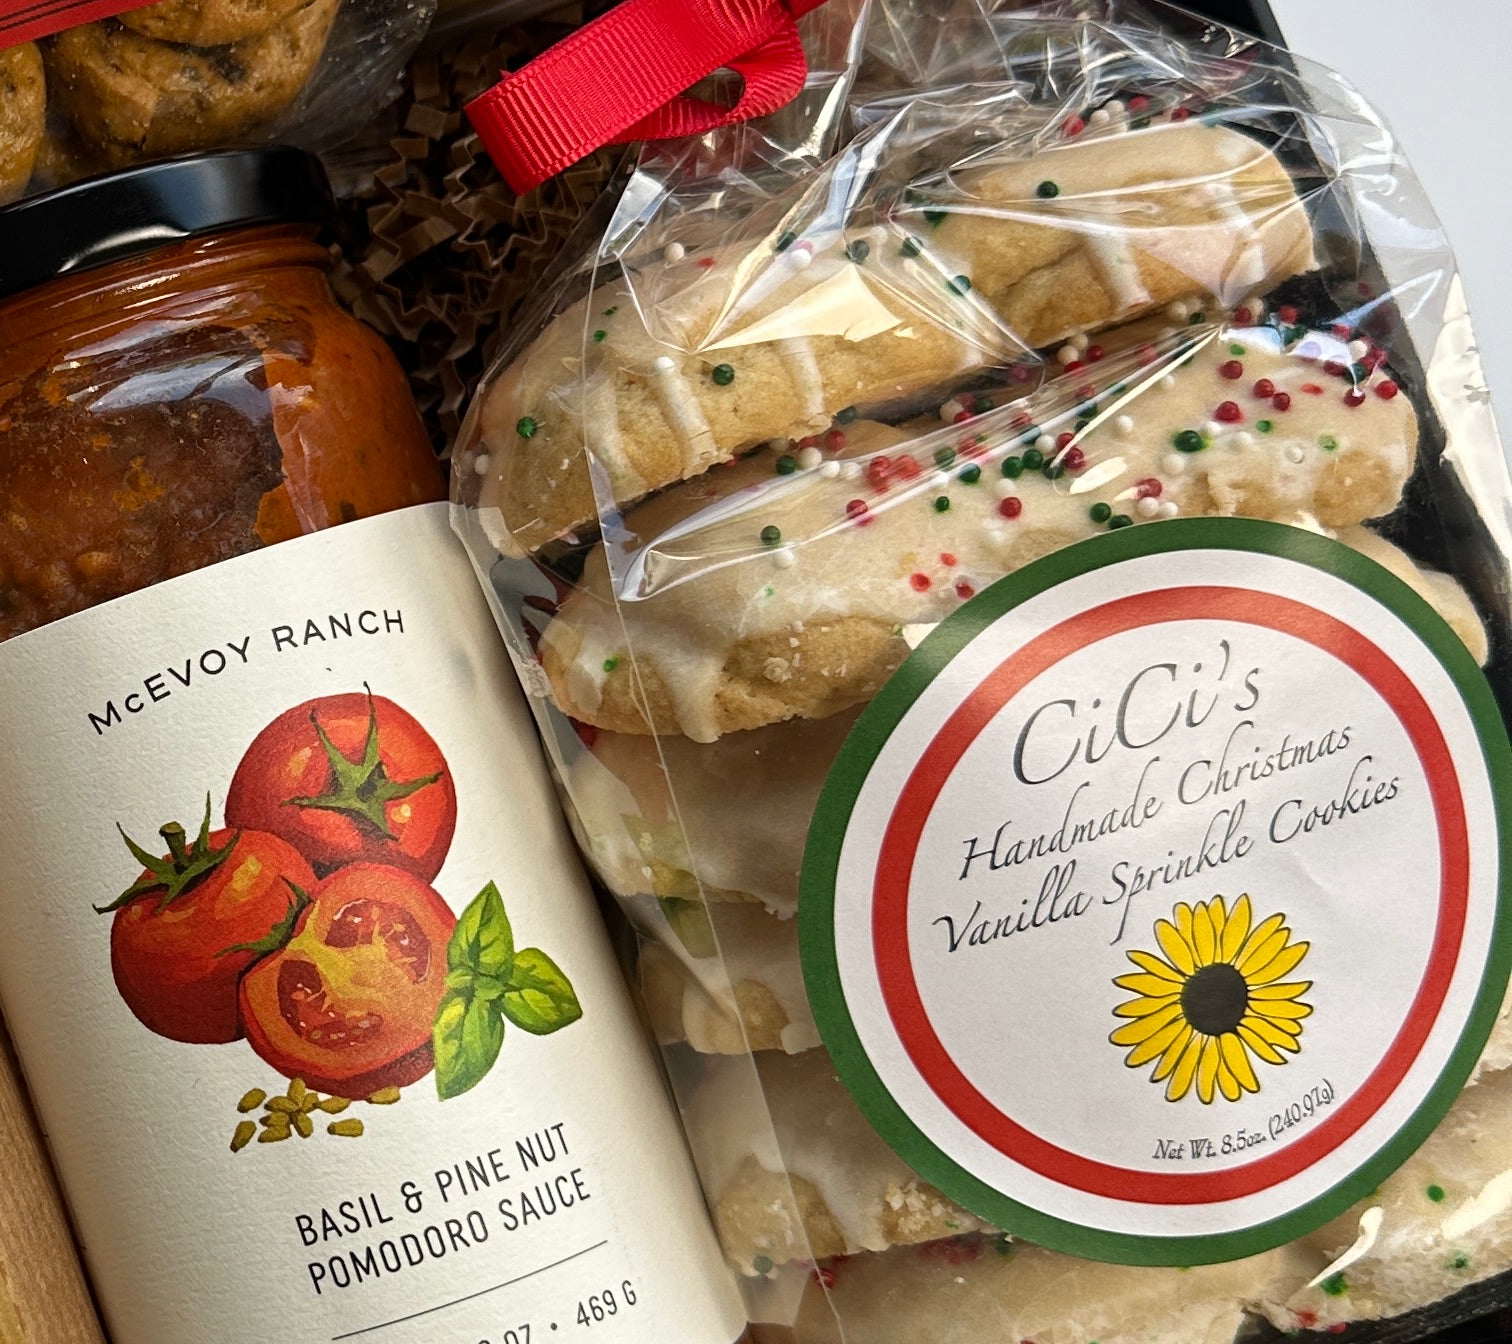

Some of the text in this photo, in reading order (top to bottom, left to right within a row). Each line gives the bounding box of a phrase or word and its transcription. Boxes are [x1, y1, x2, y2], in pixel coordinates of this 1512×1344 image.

[87, 609, 405, 735] McEVOY RANCH
[932, 756, 1400, 954] Vanilla Sprinkle Cookies
[958, 720, 1353, 882] Handmade Christmas
[296, 1123, 570, 1248] BASIL & PINE NUT
[1152, 1138, 1185, 1160] Net
[307, 1168, 593, 1295] POMODORO SAUCE
[574, 1289, 618, 1329] 469
[622, 1278, 638, 1307] G
